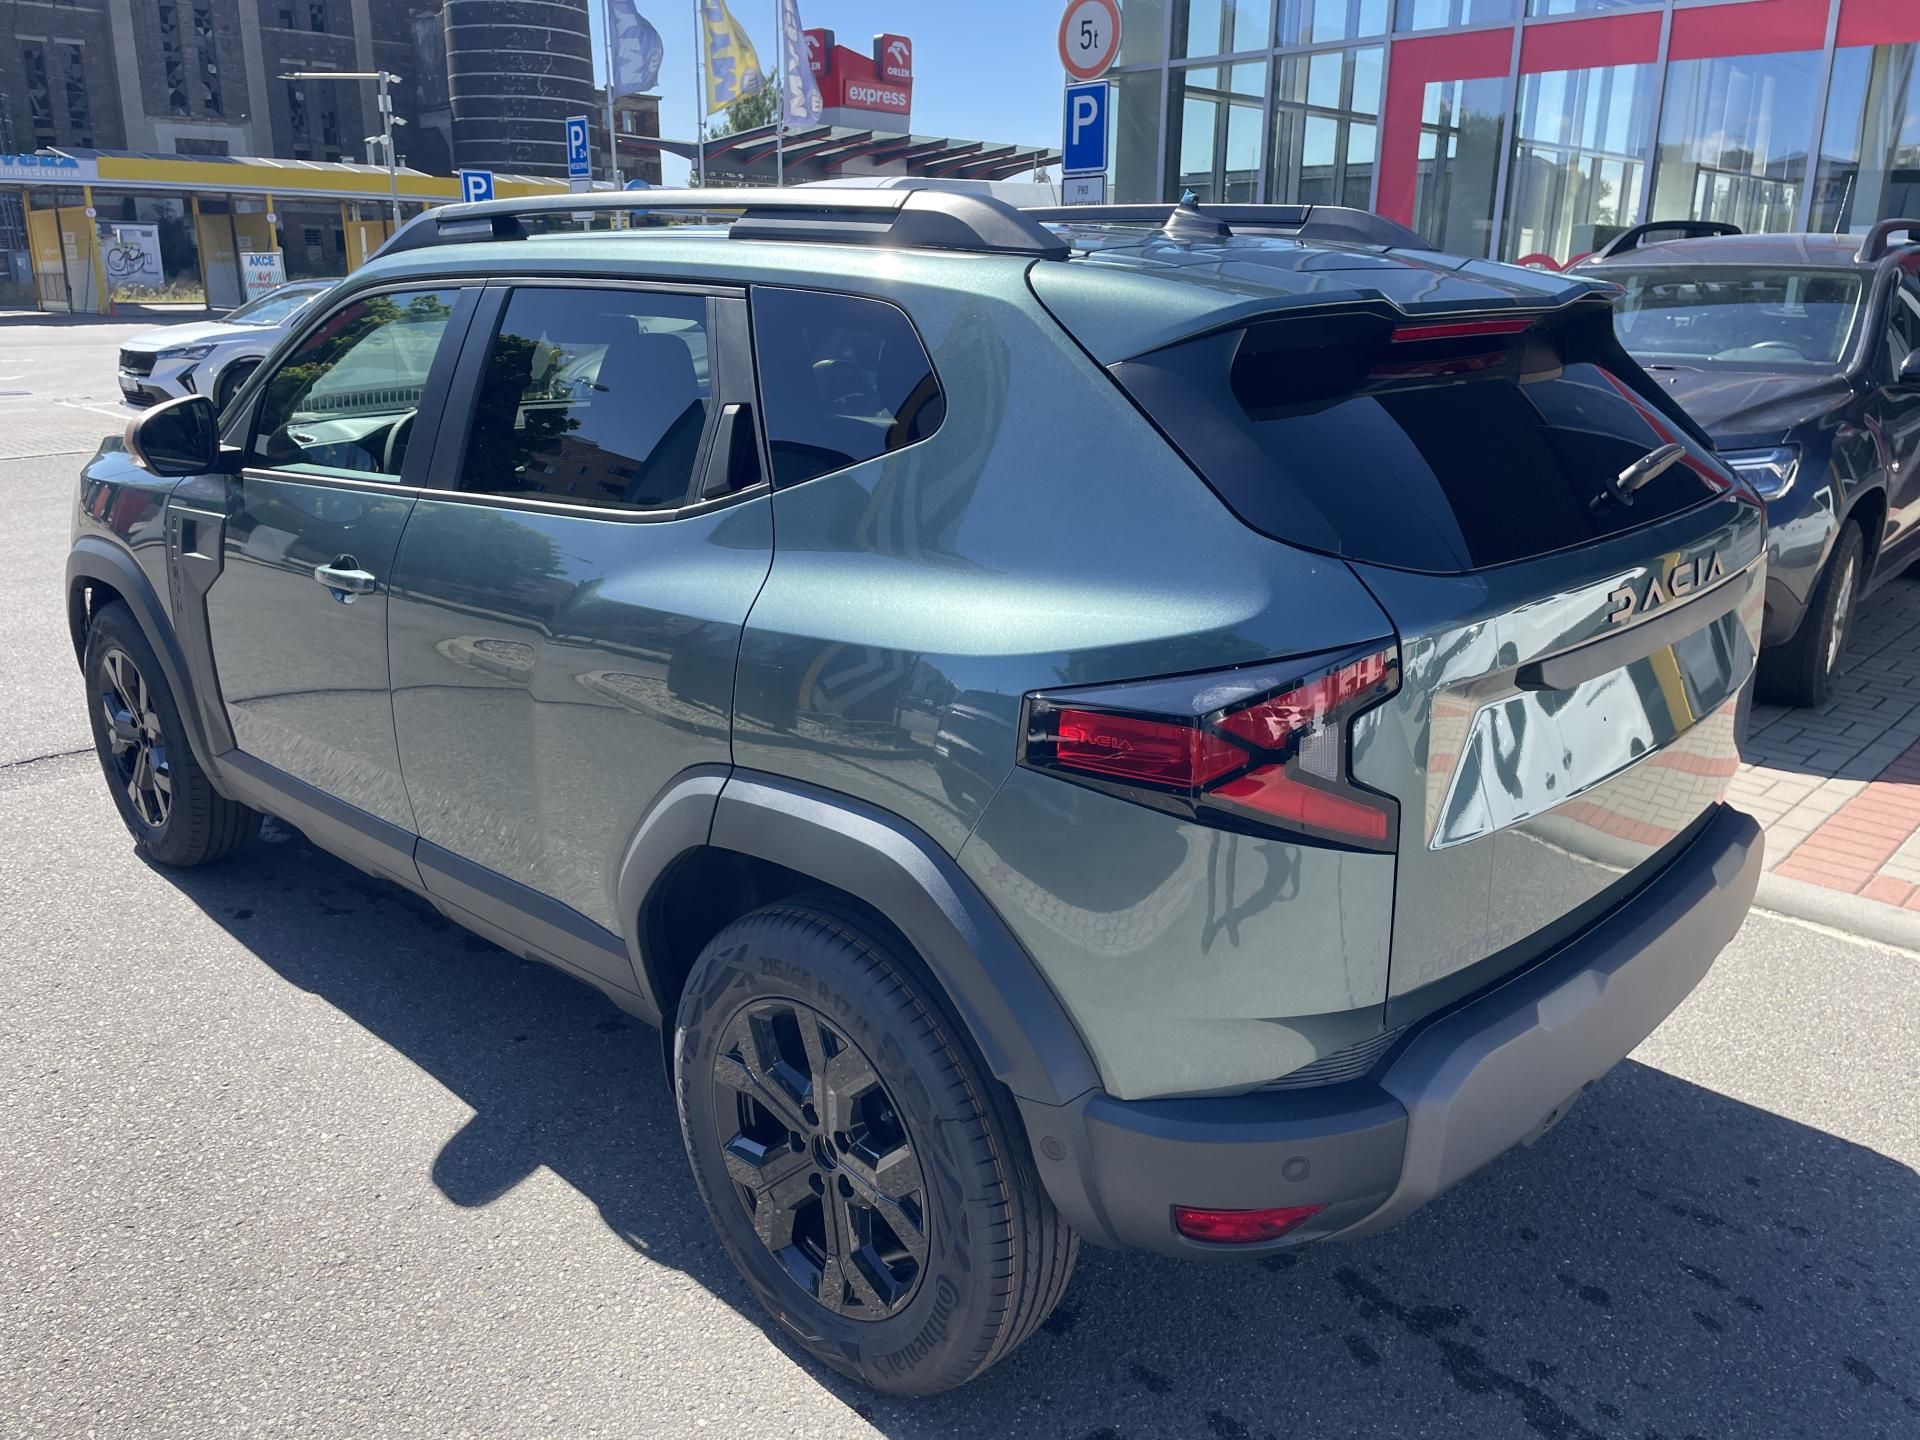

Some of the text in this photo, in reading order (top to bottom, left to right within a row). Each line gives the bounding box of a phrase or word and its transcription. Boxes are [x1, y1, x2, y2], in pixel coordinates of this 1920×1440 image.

[887, 67, 910, 77] ORLEN
[849, 85, 906, 106] express
[1072, 95, 1098, 145] P
[570, 125, 583, 159] P
[468, 176, 487, 202] P
[250, 256, 275, 266] AKCE
[1608, 551, 1725, 623] DACIA
[886, 1273, 961, 1378] Continental
